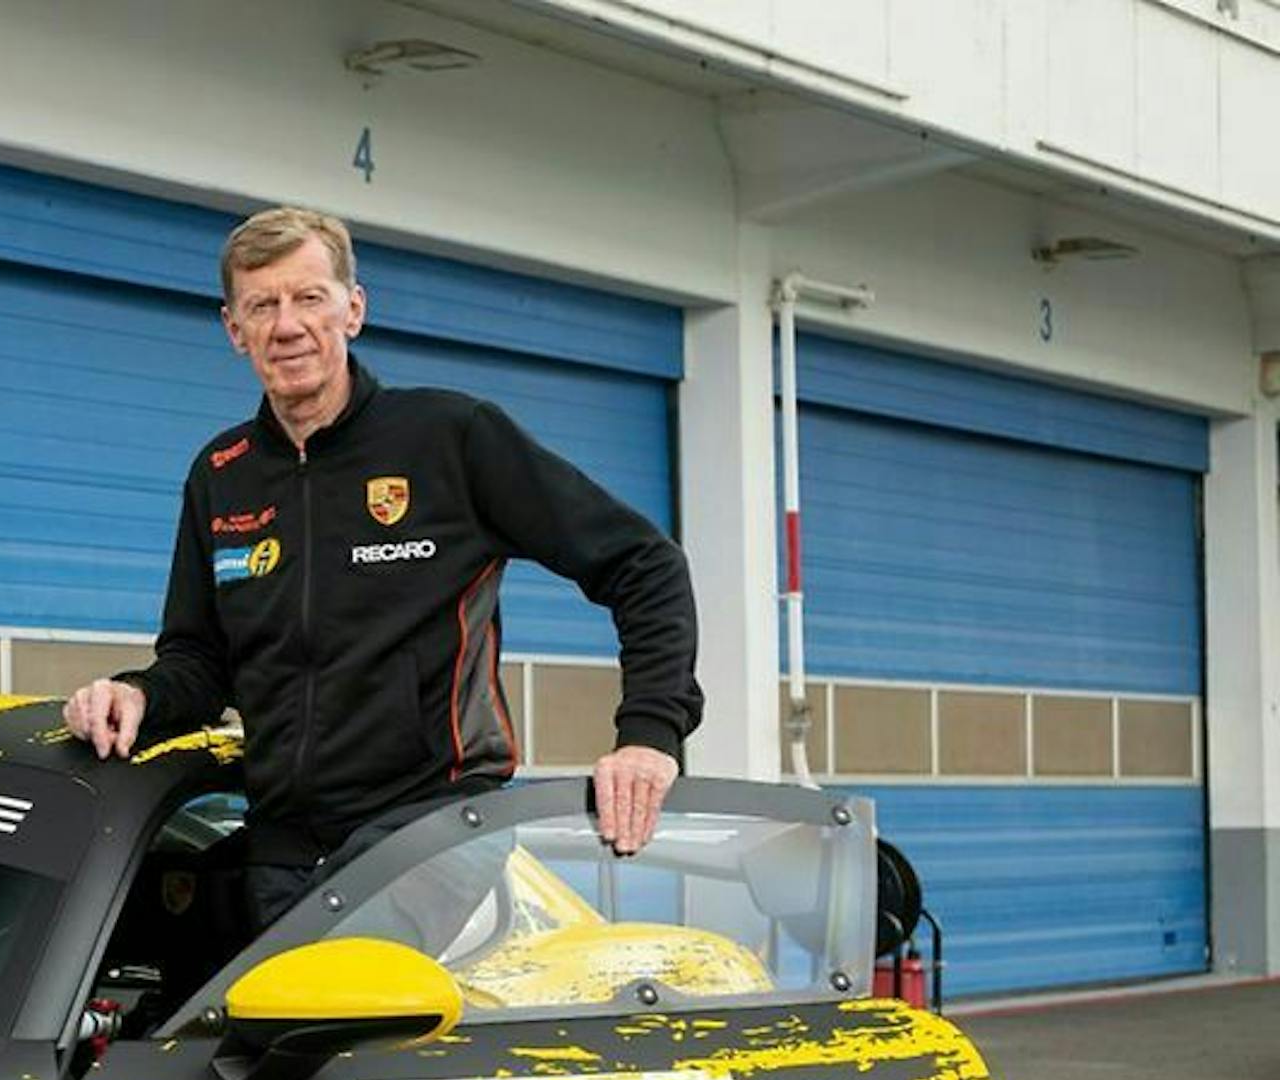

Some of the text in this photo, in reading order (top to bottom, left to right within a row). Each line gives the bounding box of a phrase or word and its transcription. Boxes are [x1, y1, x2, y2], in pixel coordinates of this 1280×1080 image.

[352, 126, 376, 184] 4
[1040, 298, 1053, 342] 3
[351, 538, 437, 564] RECARO
